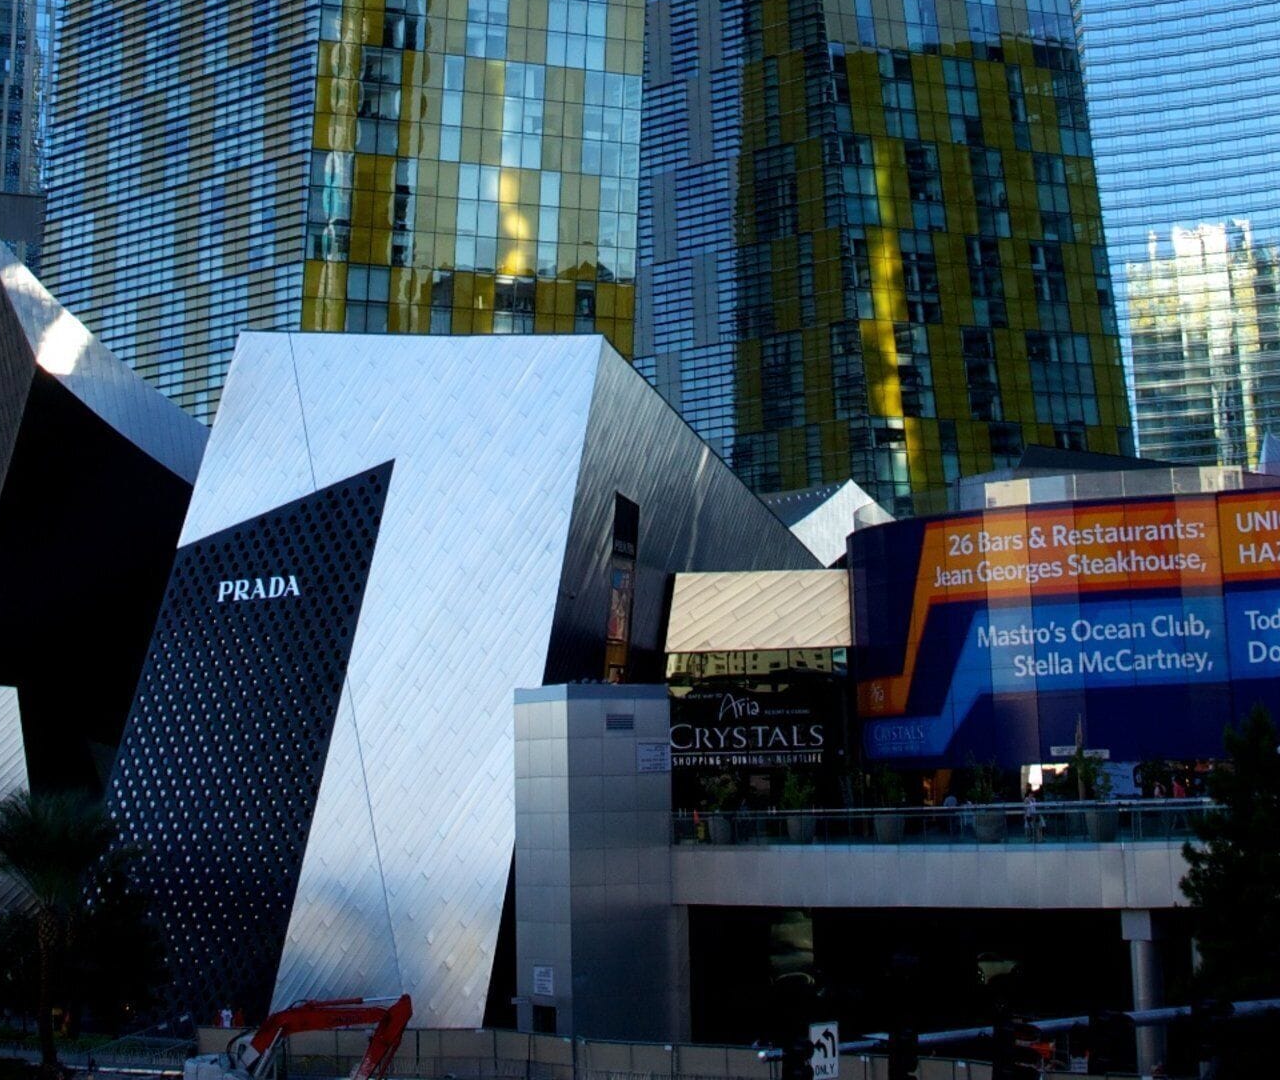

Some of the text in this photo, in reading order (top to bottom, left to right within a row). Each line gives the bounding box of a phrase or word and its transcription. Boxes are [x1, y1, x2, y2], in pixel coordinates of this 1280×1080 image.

[948, 519, 1205, 556] 26 Bars & Restaurants:
[934, 549, 1207, 587] Jean Georges Steakhouse,
[216, 574, 301, 603] PRADA
[977, 613, 1211, 648] Mastro's Ocean Club,
[1013, 648, 1214, 678] Stella McCartney,
[719, 692, 761, 721] Aria
[669, 722, 825, 750] CRYSTALS
[814, 1063, 836, 1077] ONLY
